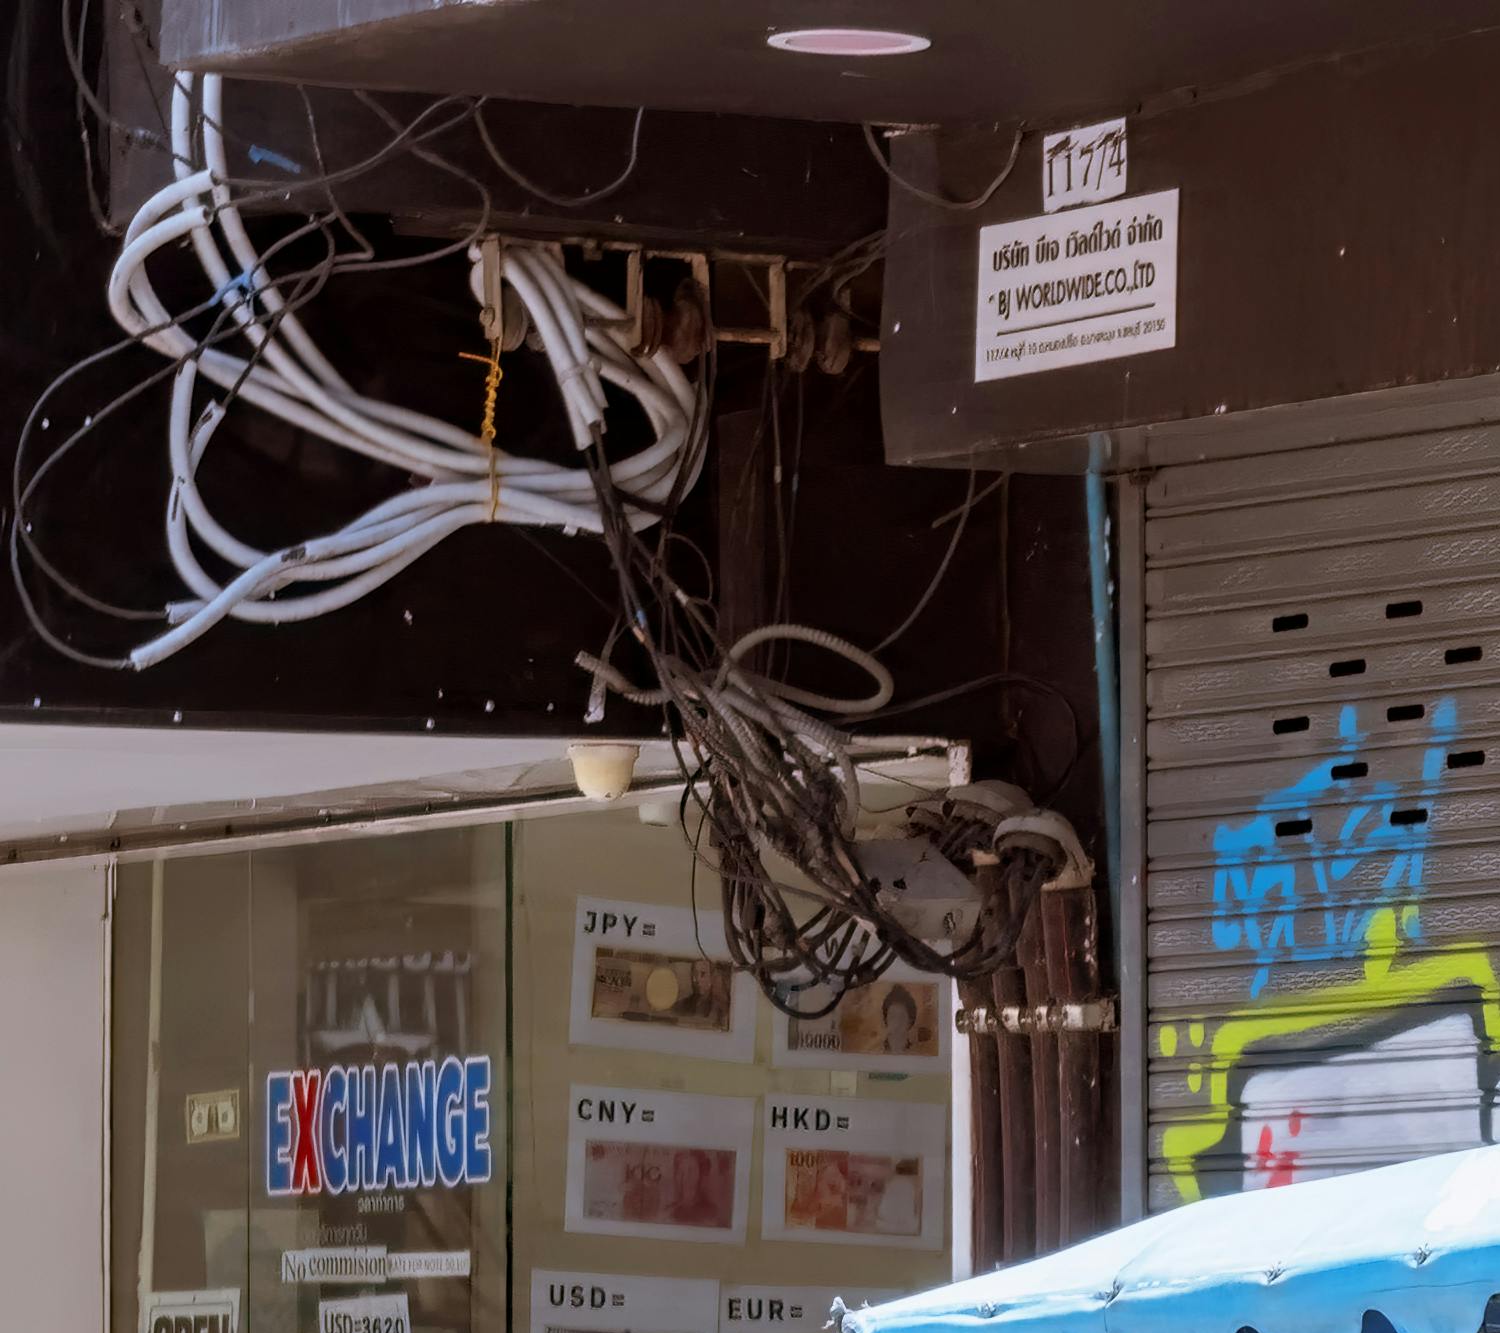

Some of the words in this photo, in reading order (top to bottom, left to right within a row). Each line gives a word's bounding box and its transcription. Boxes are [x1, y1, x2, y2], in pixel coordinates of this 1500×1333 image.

[1047, 130, 1126, 197] 117/4
[993, 239, 1029, 272] บริษัท
[1128, 215, 1162, 247] จำกัด
[998, 289, 1010, 320] BJ
[267, 1055, 491, 1196] EXCHANGE
[285, 1255, 307, 1281] No
[308, 1249, 386, 1277] commision
